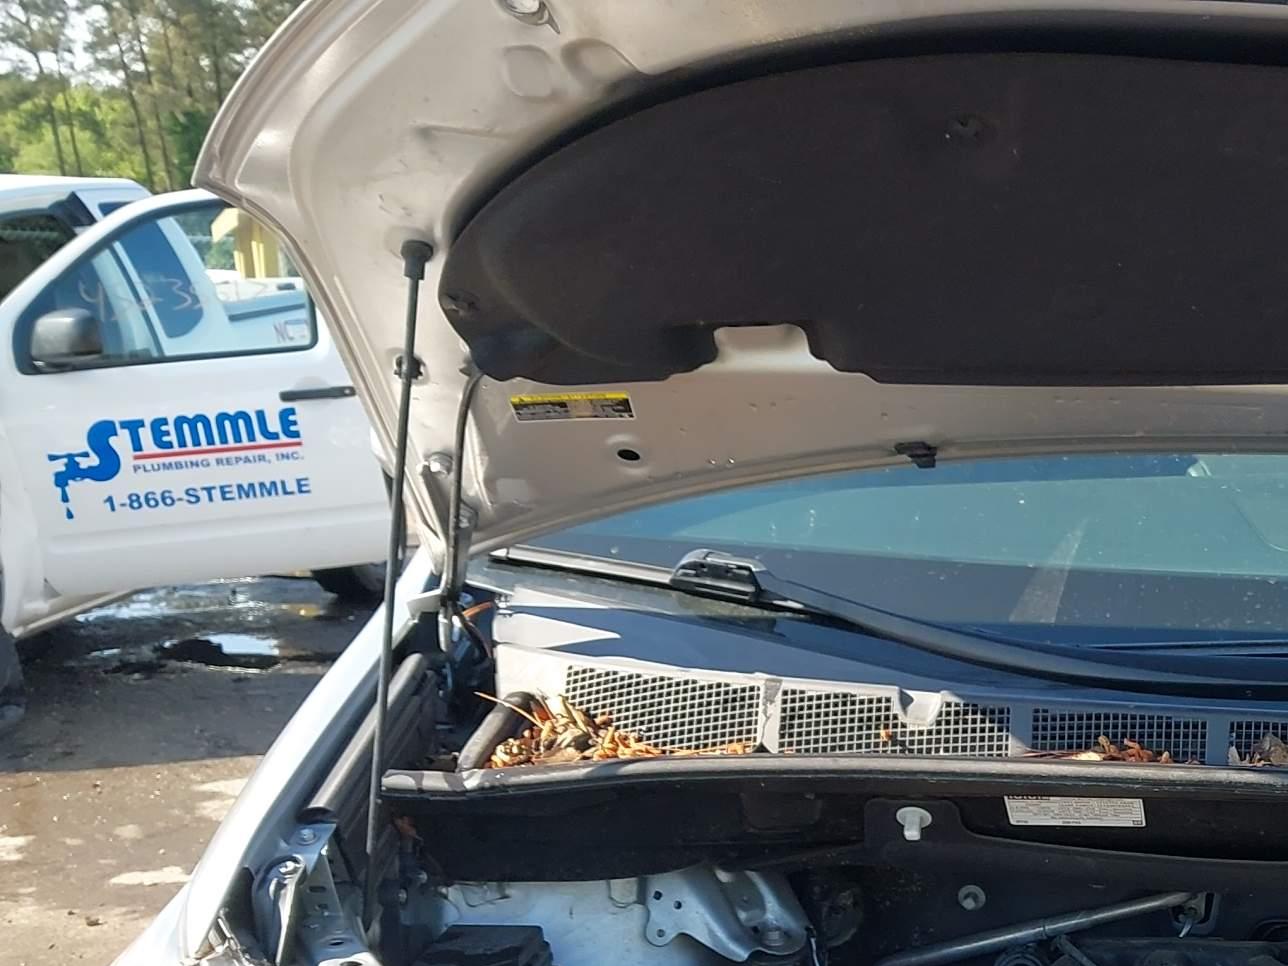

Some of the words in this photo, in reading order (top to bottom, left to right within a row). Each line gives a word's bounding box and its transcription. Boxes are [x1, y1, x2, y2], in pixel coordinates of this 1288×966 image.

[86, 407, 301, 482] STEMMLE
[132, 460, 211, 474] PLUMBING
[216, 454, 271, 467] REPAIR,
[276, 451, 304, 462] INC.
[103, 477, 312, 513] 1-866-STEMMLE
